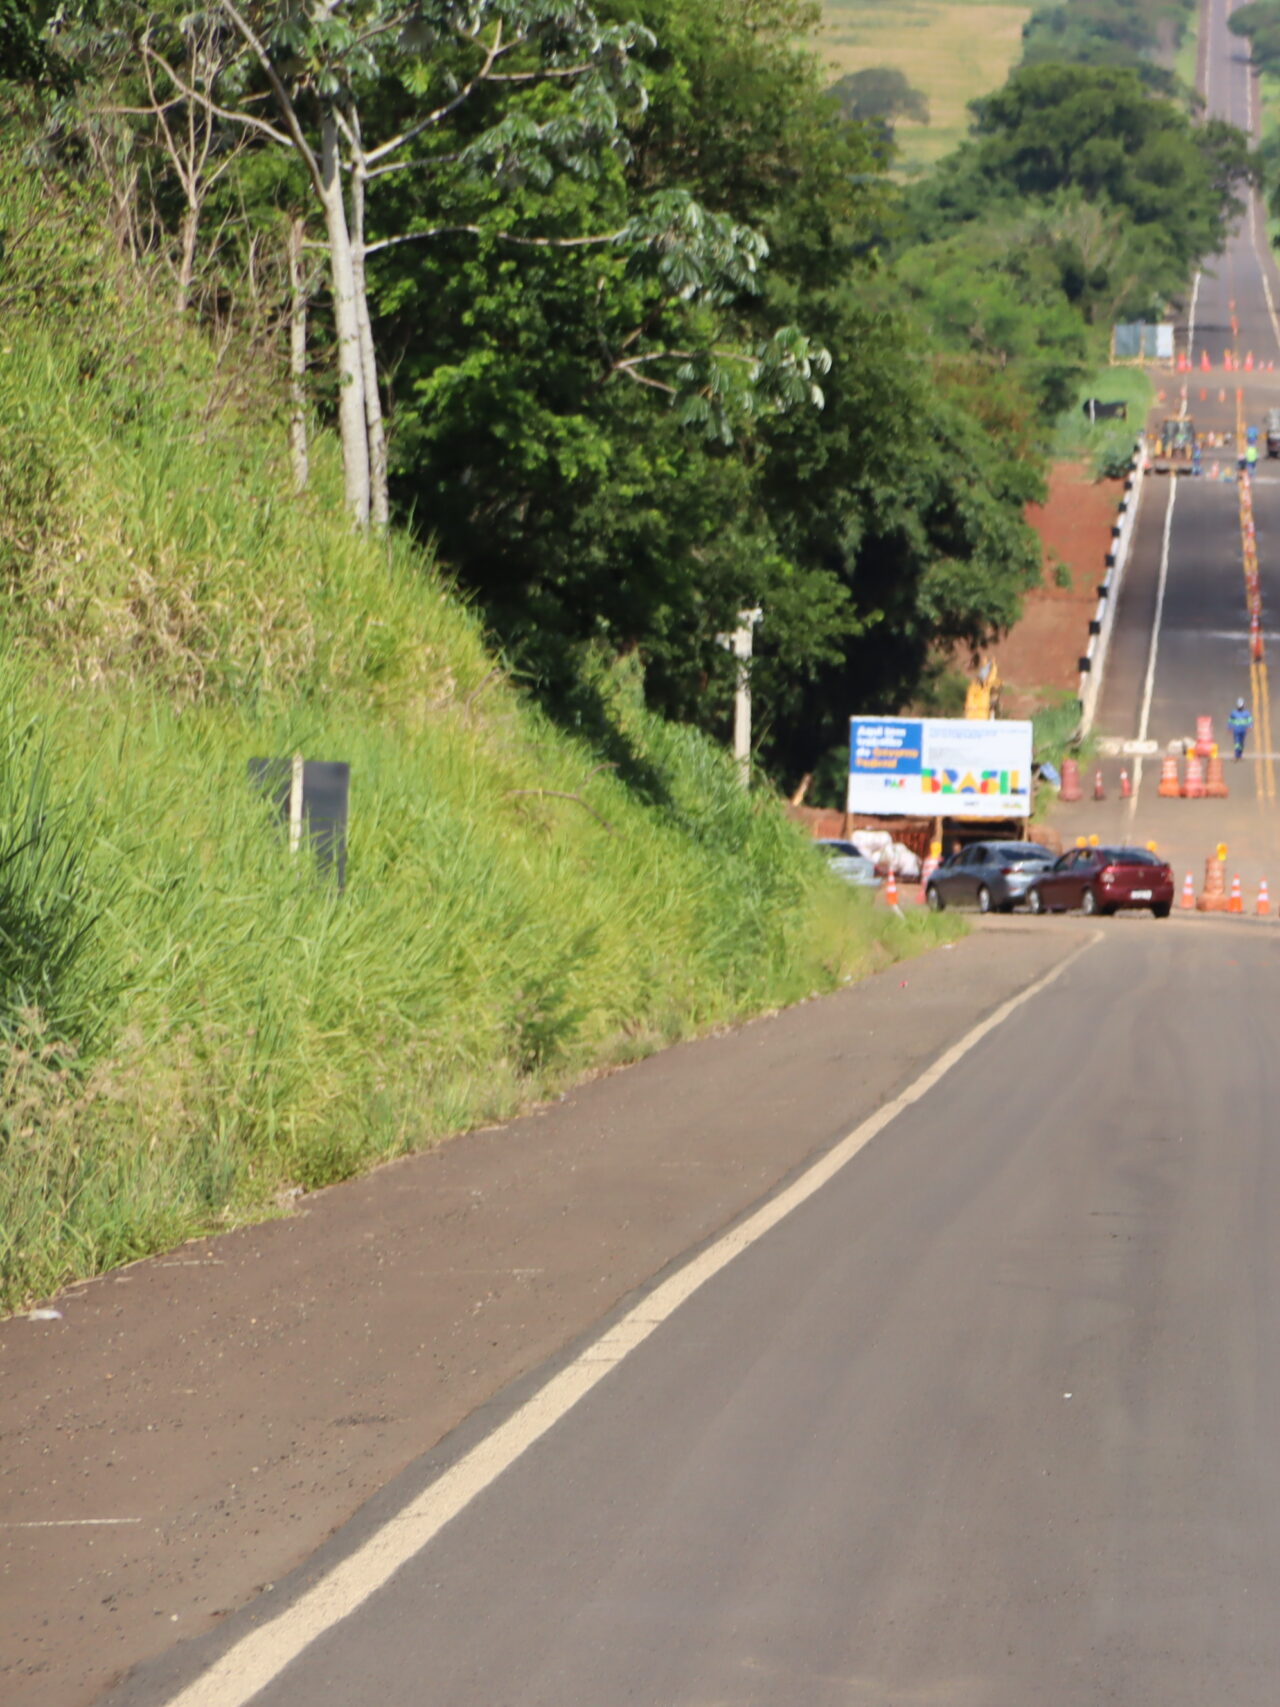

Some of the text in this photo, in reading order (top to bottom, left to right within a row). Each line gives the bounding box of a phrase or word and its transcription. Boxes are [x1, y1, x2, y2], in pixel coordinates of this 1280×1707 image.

[872, 748, 919, 758] Governo
[855, 758, 898, 768] Federal
[921, 768, 1027, 795] BRASIL
